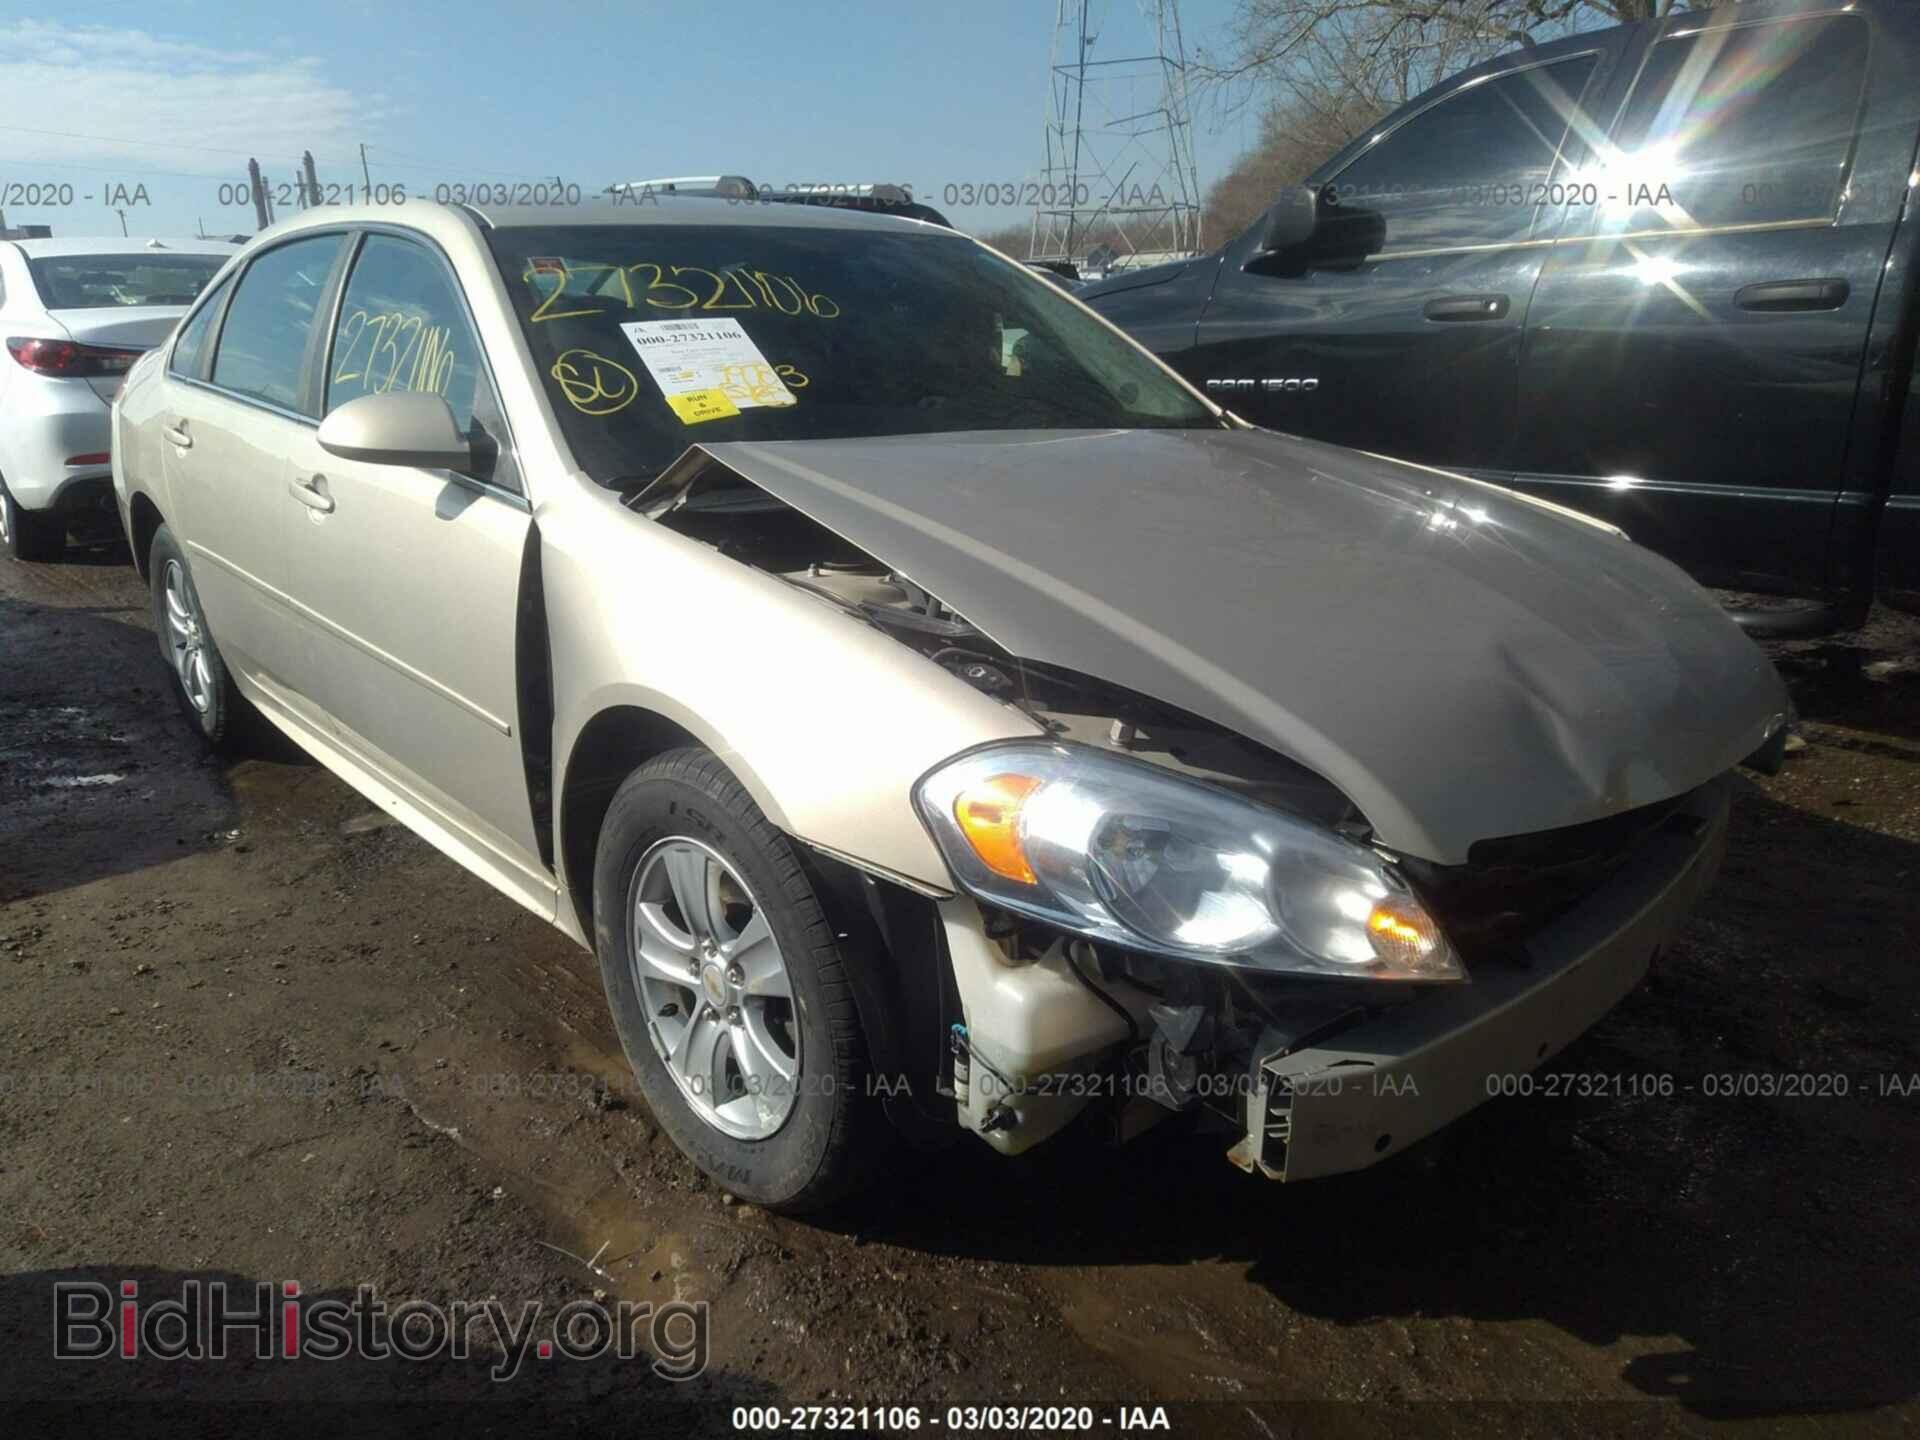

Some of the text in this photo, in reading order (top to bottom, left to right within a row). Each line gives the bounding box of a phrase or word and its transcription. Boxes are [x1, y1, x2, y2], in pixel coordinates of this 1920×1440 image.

[636, 331, 743, 346] 000-27321106
[1206, 378, 1319, 392] RAM 1500
